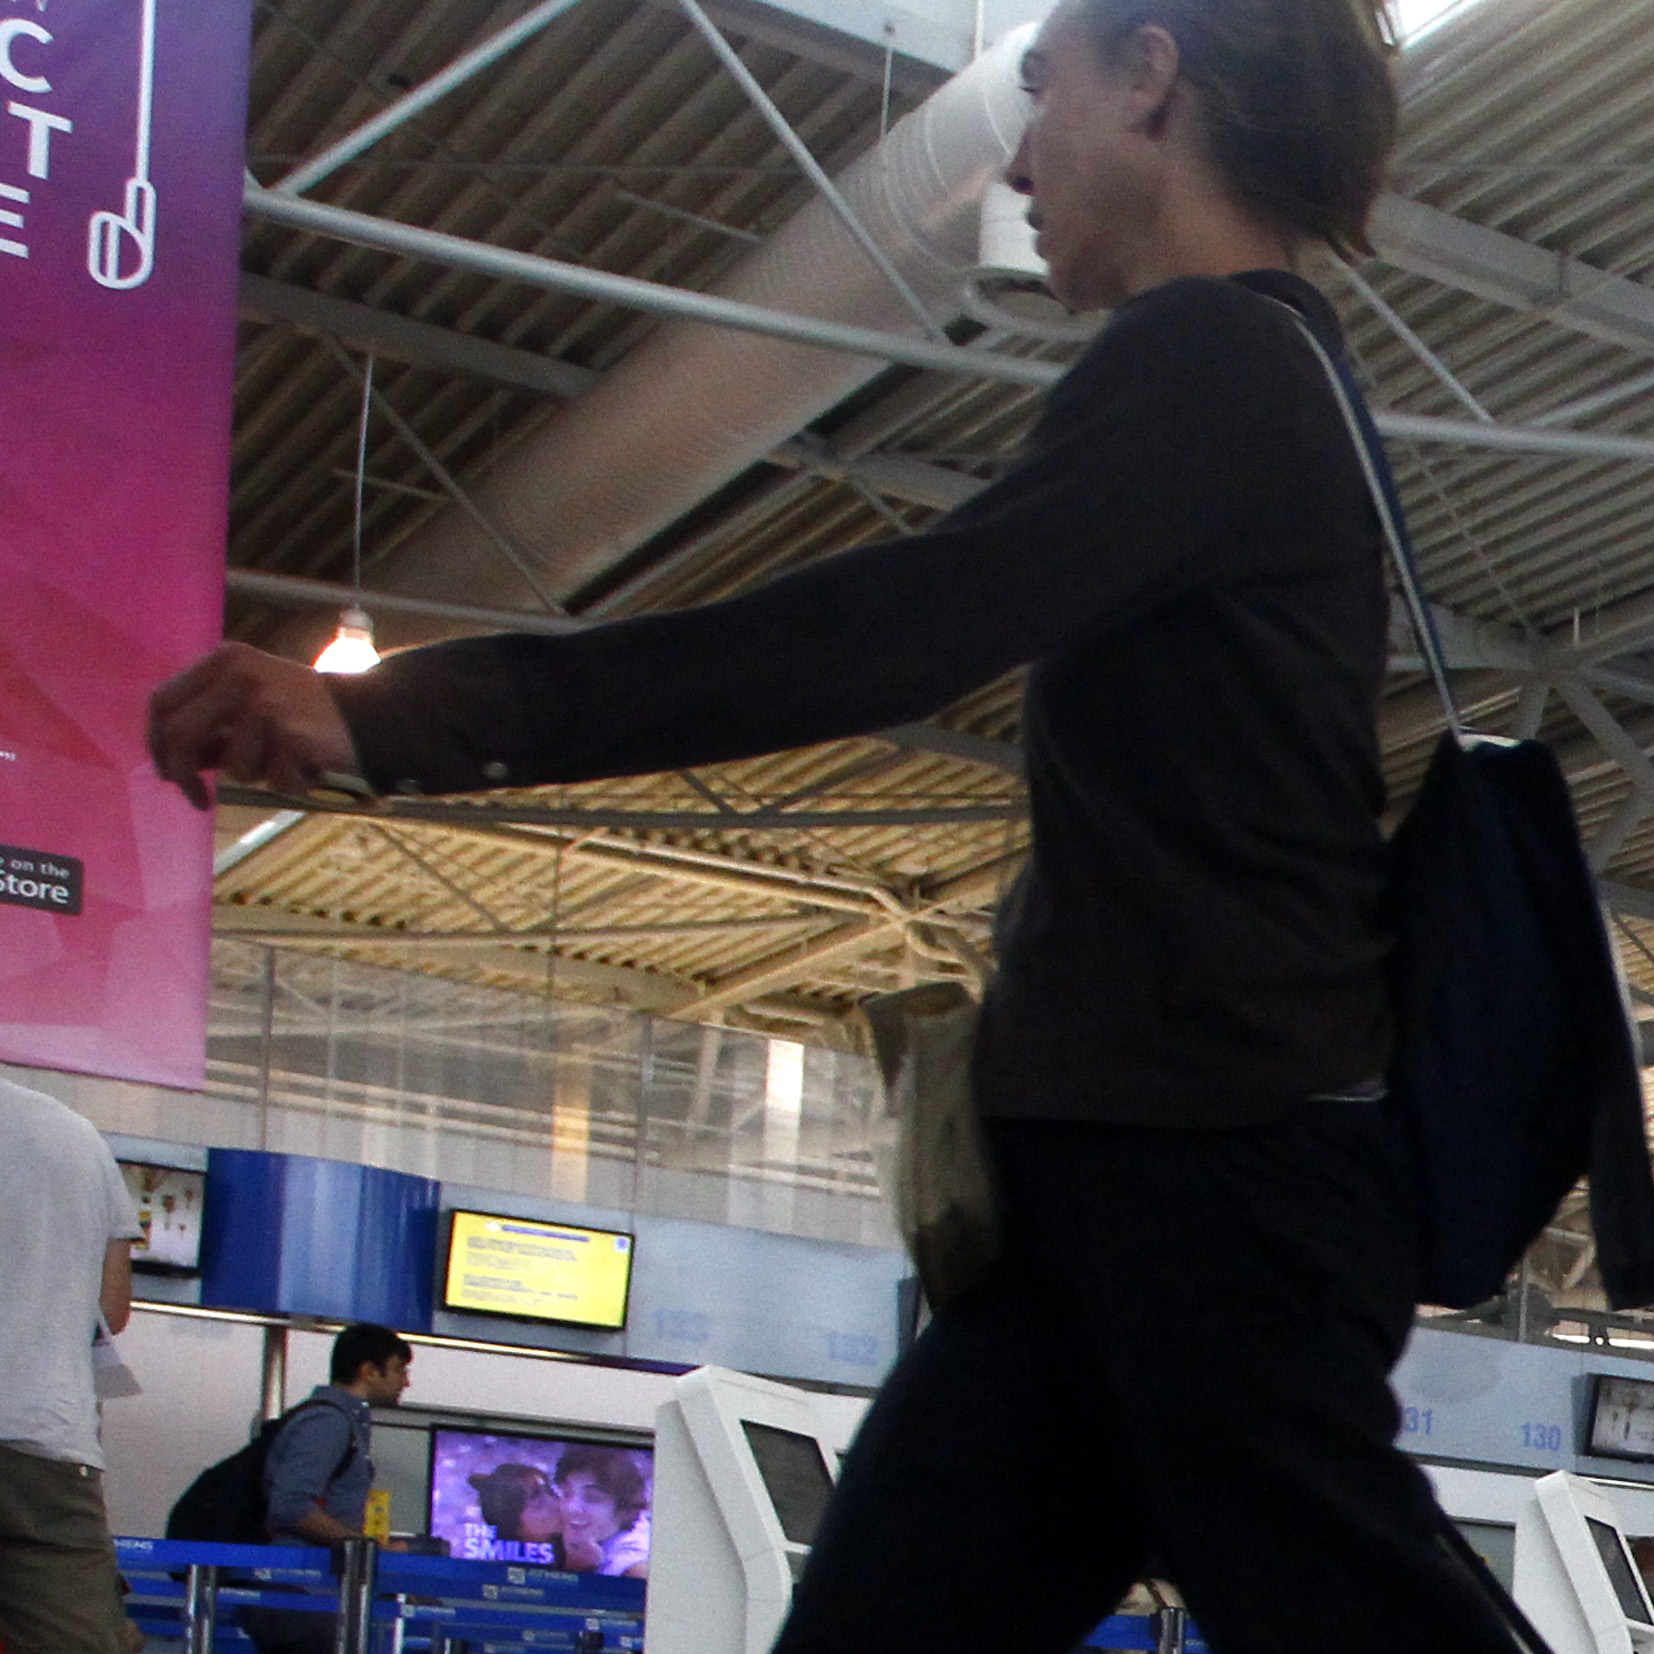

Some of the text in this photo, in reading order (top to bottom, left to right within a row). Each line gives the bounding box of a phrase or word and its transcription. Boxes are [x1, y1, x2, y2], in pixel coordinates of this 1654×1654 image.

[11, 859, 71, 879] on the
[1402, 1406, 1433, 1435] 31
[1521, 1421, 1562, 1451] 130
[464, 1523, 498, 1539] THE
[463, 1538, 556, 1565] SMILES
